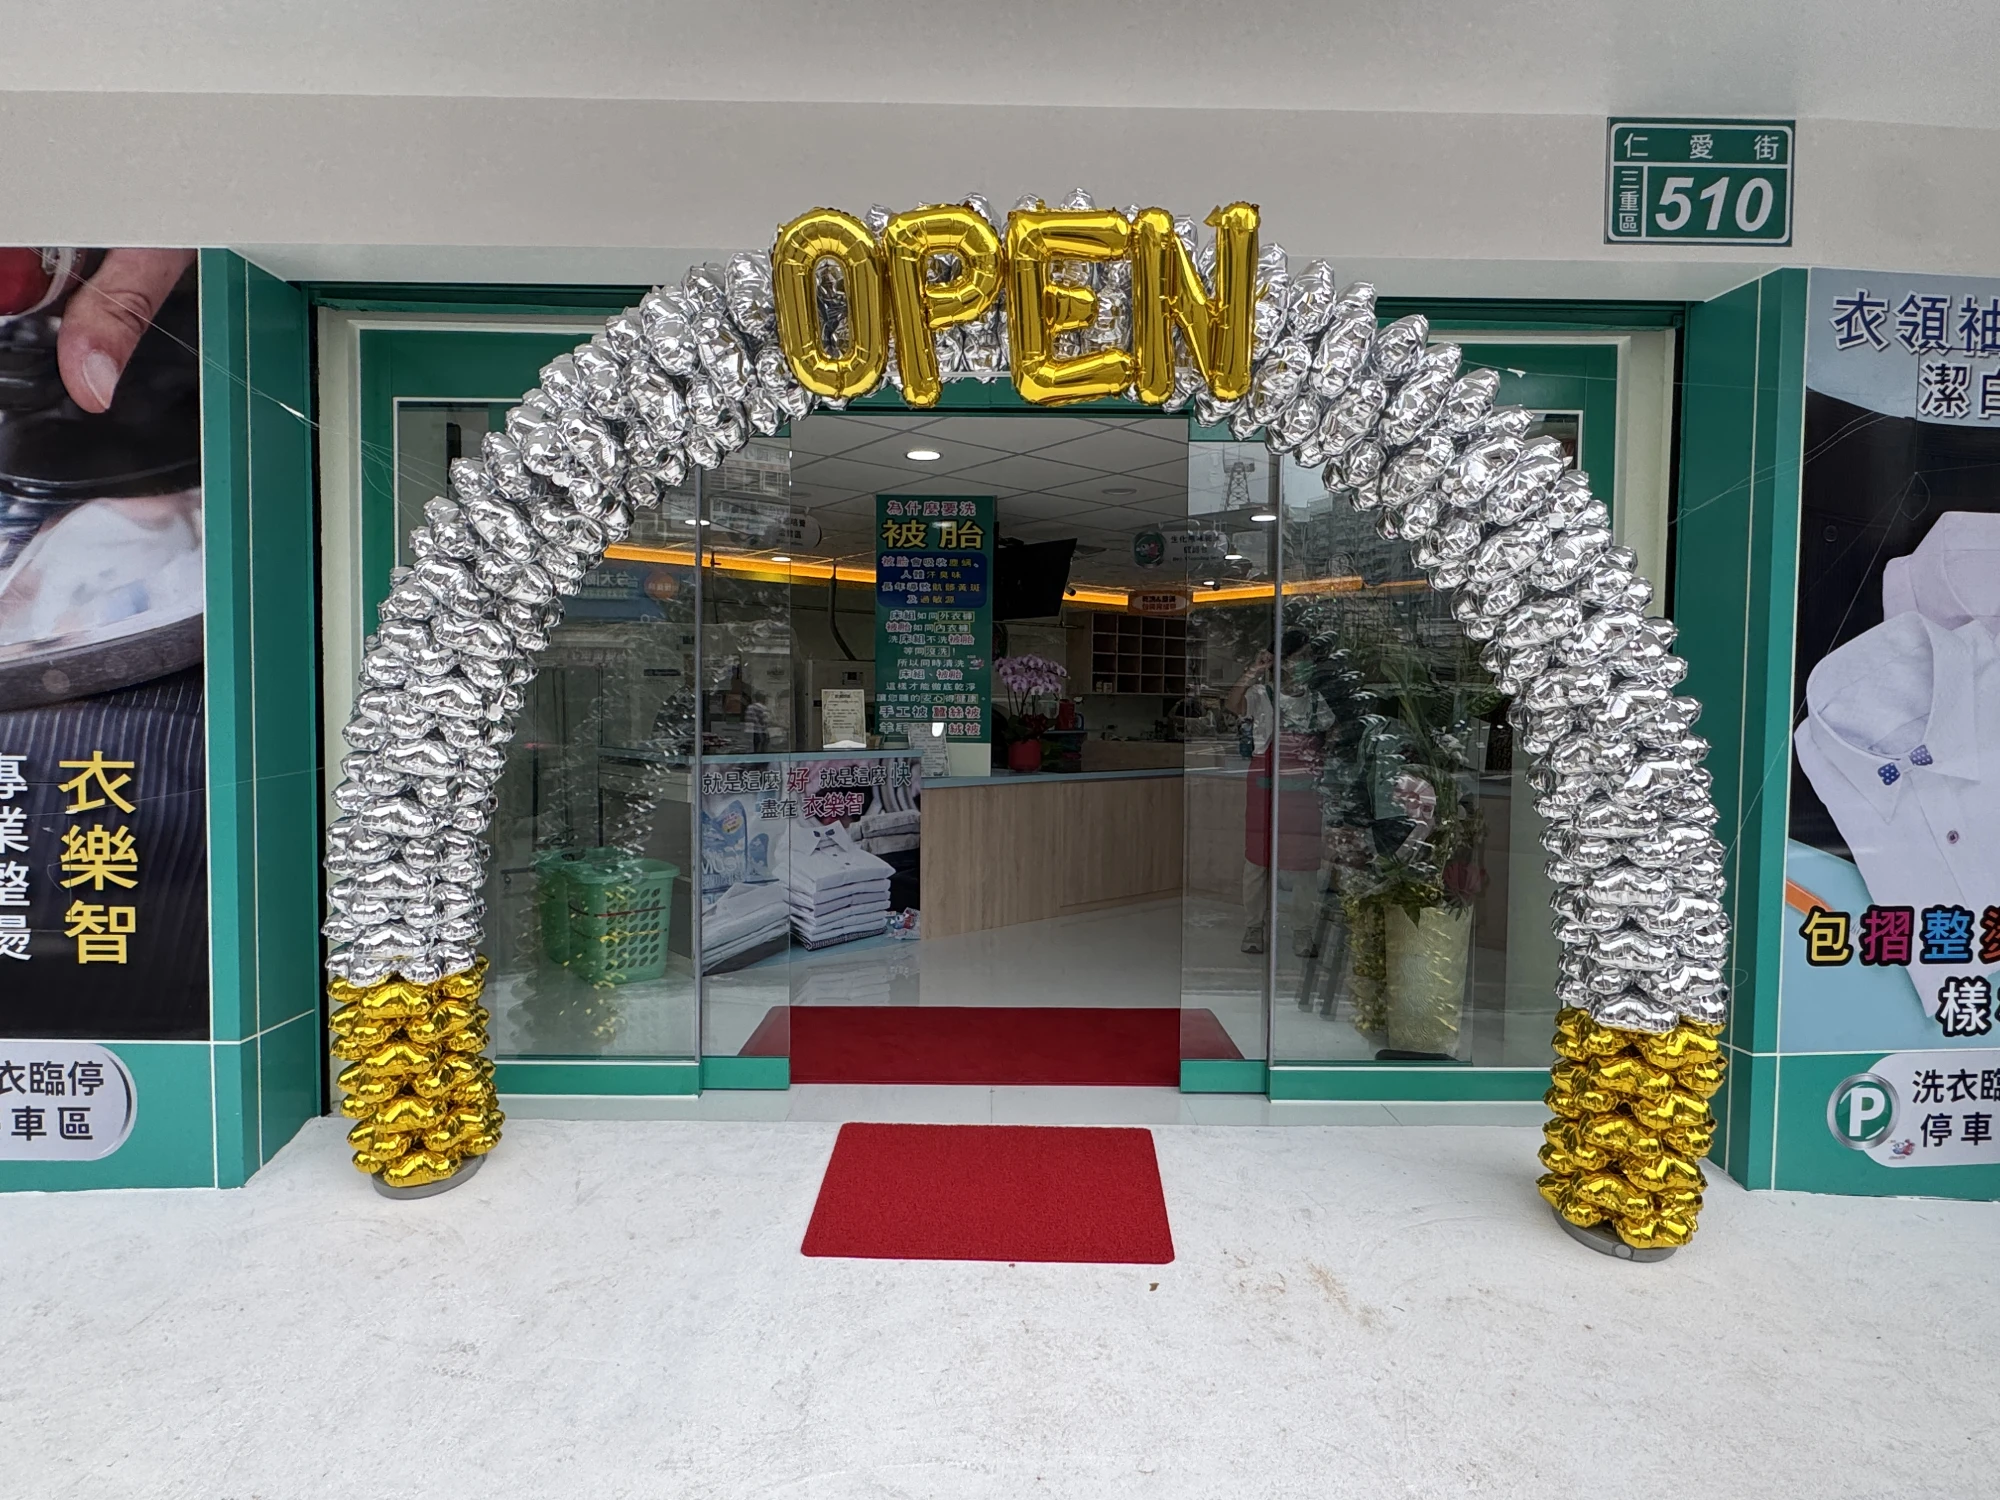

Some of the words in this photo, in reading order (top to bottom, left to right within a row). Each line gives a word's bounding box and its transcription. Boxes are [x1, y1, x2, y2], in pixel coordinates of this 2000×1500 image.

[1624, 133, 1779, 160] 仁愛街
[1619, 170, 1640, 232] 三重區
[1655, 176, 1774, 232] 510
[773, 201, 1259, 407] OPEN
[1831, 289, 2000, 354] 衣領袖
[882, 519, 984, 549] 被胎
[887, 500, 976, 516] 為什麼要洗
[879, 705, 928, 718] 手工被
[59, 751, 138, 964] 衣樂智
[1938, 977, 2000, 1034] 樣
[1849, 1087, 1886, 1137] P
[1920, 1112, 1992, 1147] 停車
